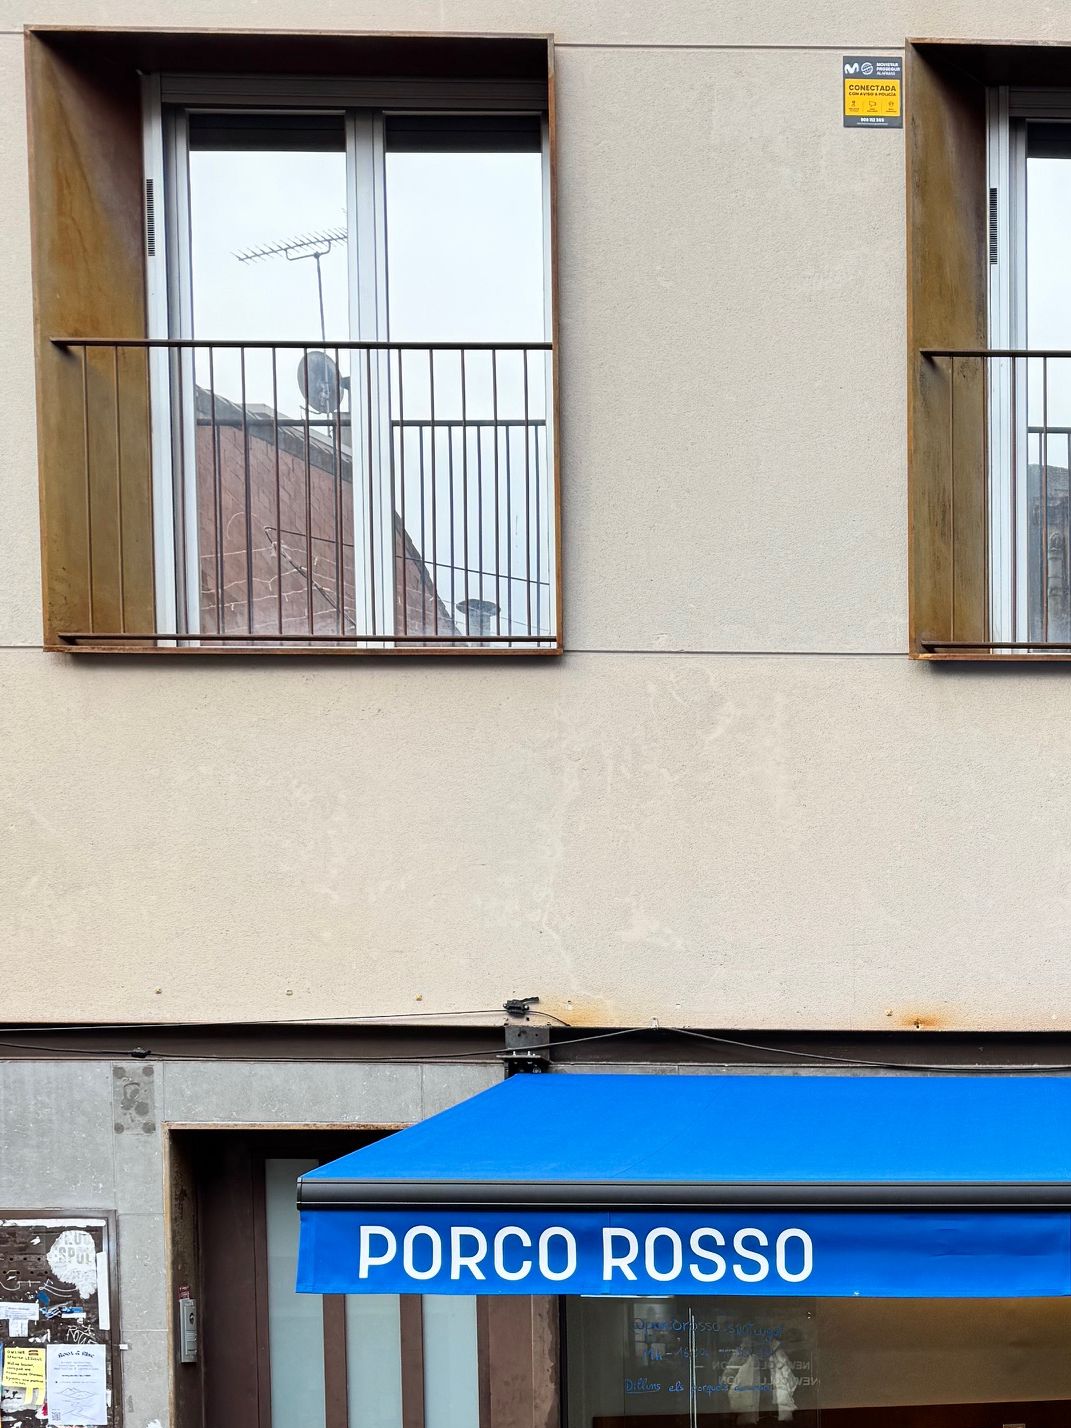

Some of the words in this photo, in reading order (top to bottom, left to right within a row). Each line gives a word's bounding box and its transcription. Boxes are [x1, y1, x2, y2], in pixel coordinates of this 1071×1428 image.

[848, 84, 897, 92] CONECTADA
[358, 1225, 578, 1281] PORCO
[602, 1227, 814, 1283] ROSSO
